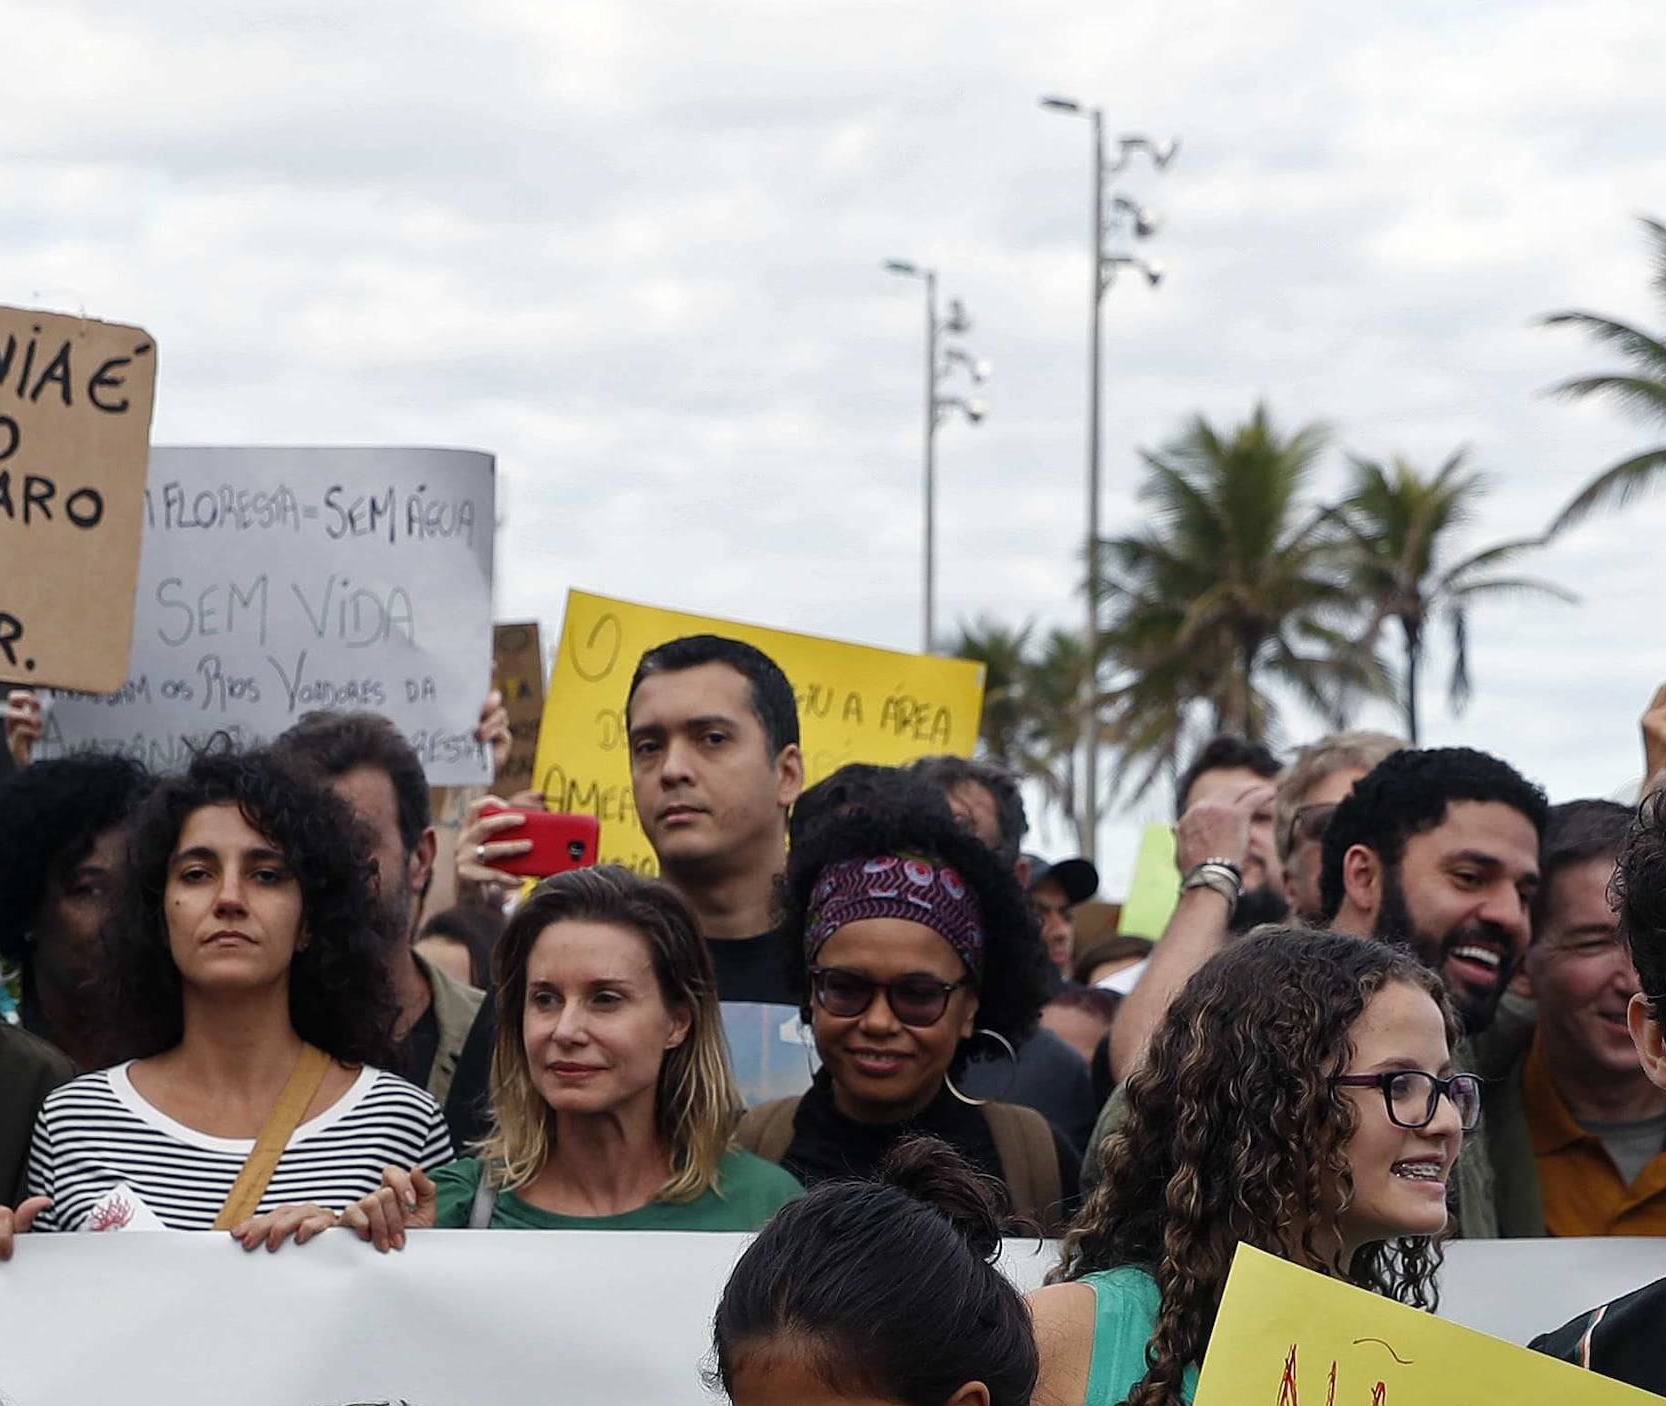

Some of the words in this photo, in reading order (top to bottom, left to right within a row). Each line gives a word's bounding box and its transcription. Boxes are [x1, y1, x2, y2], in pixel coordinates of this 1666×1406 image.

[88, 343, 153, 412] É
[155, 573, 270, 648] SEM
[290, 572, 417, 650] VIDA
